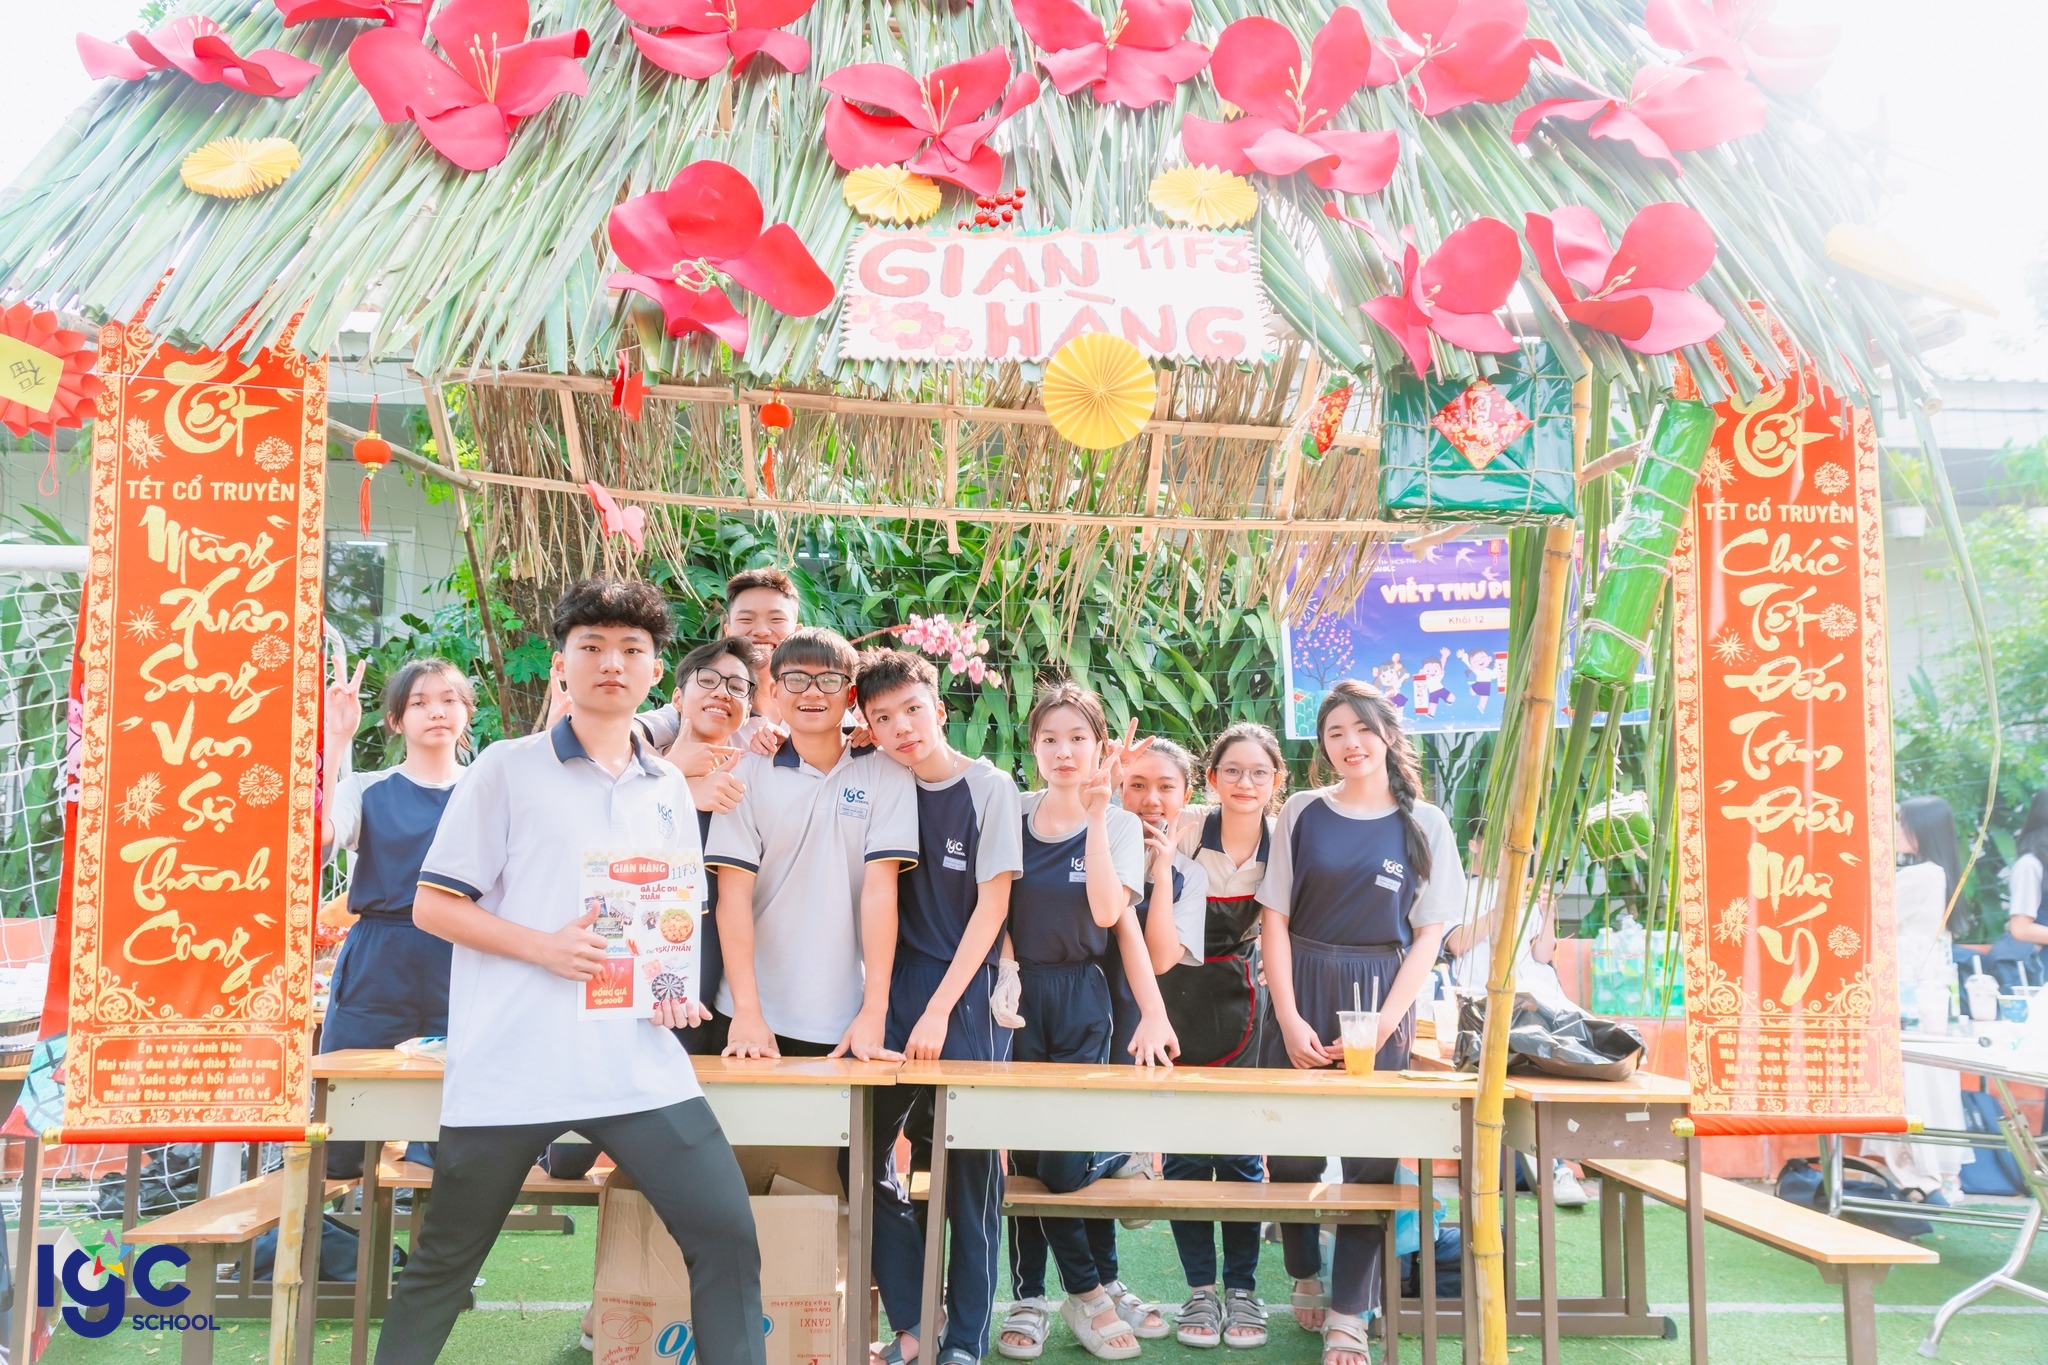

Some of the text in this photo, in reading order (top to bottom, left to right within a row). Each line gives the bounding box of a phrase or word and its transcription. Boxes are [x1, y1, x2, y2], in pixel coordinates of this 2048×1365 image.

[858, 234, 1251, 298] GIAN 11F3
[984, 289, 1247, 359] HÀNG
[163, 352, 280, 457] Tết
[1729, 380, 1834, 481] Tết
[126, 474, 295, 502] TẾT CỔ TRUYỀN
[1702, 497, 1854, 524] TẾT CỔ TRUYỀN
[138, 504, 296, 593] Mừng
[1717, 528, 1847, 576] Chúc
[160, 567, 289, 670] Xuân
[1381, 576, 1435, 605] VIẾT
[1437, 579, 1487, 602] THƯ
[1448, 614, 1485, 624] Khối 12
[1739, 582, 1826, 651] Tết
[140, 643, 283, 724] Sang
[1723, 652, 1847, 702] Đến
[151, 700, 252, 769] Vạn
[178, 771, 236, 833] Sự
[119, 836, 271, 911] Thành
[613, 864, 637, 873] GIAN
[639, 861, 666, 873] HÀNG
[640, 885, 650, 893] GÀ
[653, 883, 666, 893] LẮC
[640, 892, 661, 900] XUÂN
[122, 909, 273, 994] Công
[800, 1318, 831, 1327] CANXI
